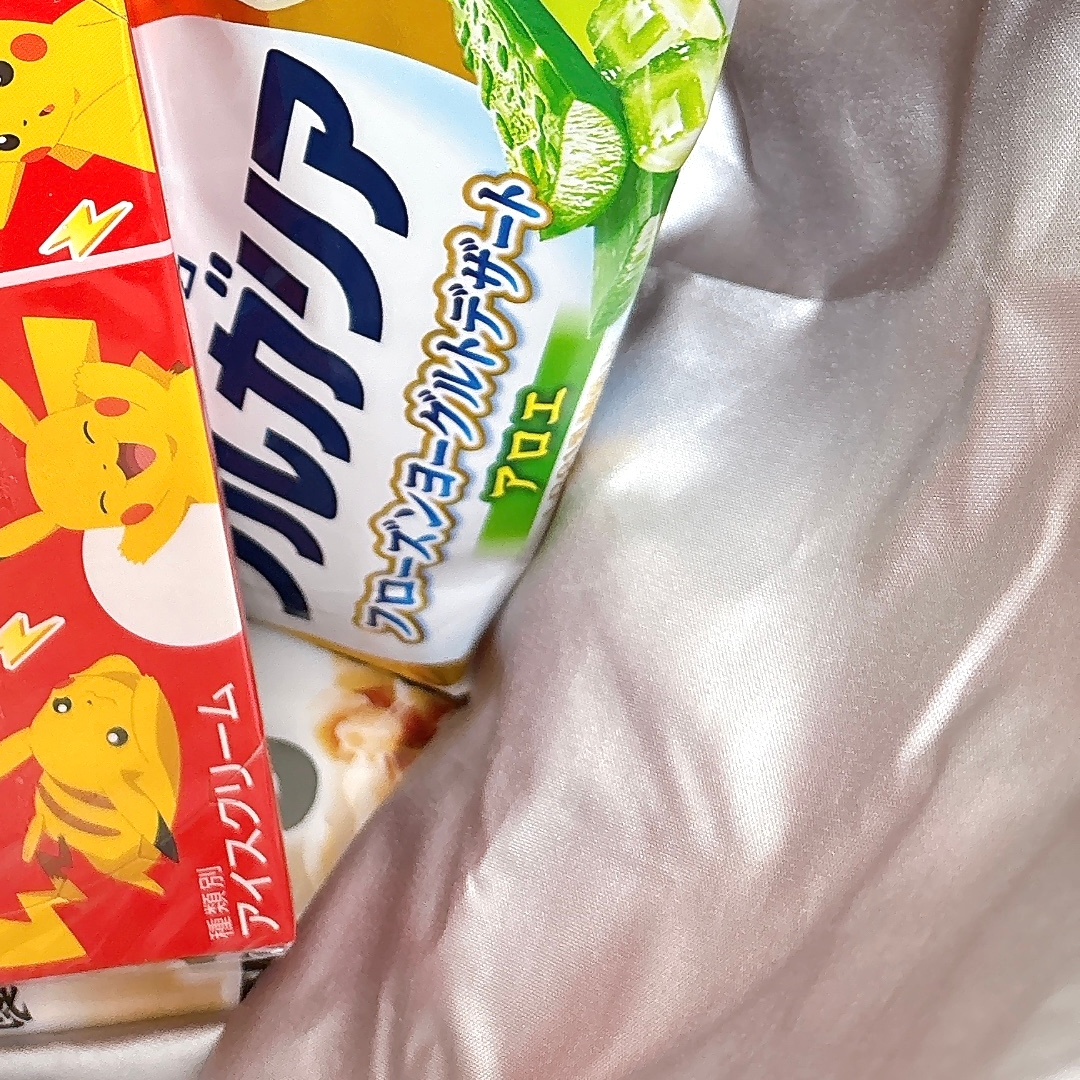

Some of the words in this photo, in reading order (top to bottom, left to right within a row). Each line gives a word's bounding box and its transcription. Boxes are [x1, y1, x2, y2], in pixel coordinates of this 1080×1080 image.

[366, 183, 543, 638] フローズンヨーグルトデザート
[491, 385, 568, 500] アロエ
[196, 682, 281, 938] アイスクリーム
[195, 865, 236, 942] 種類別
